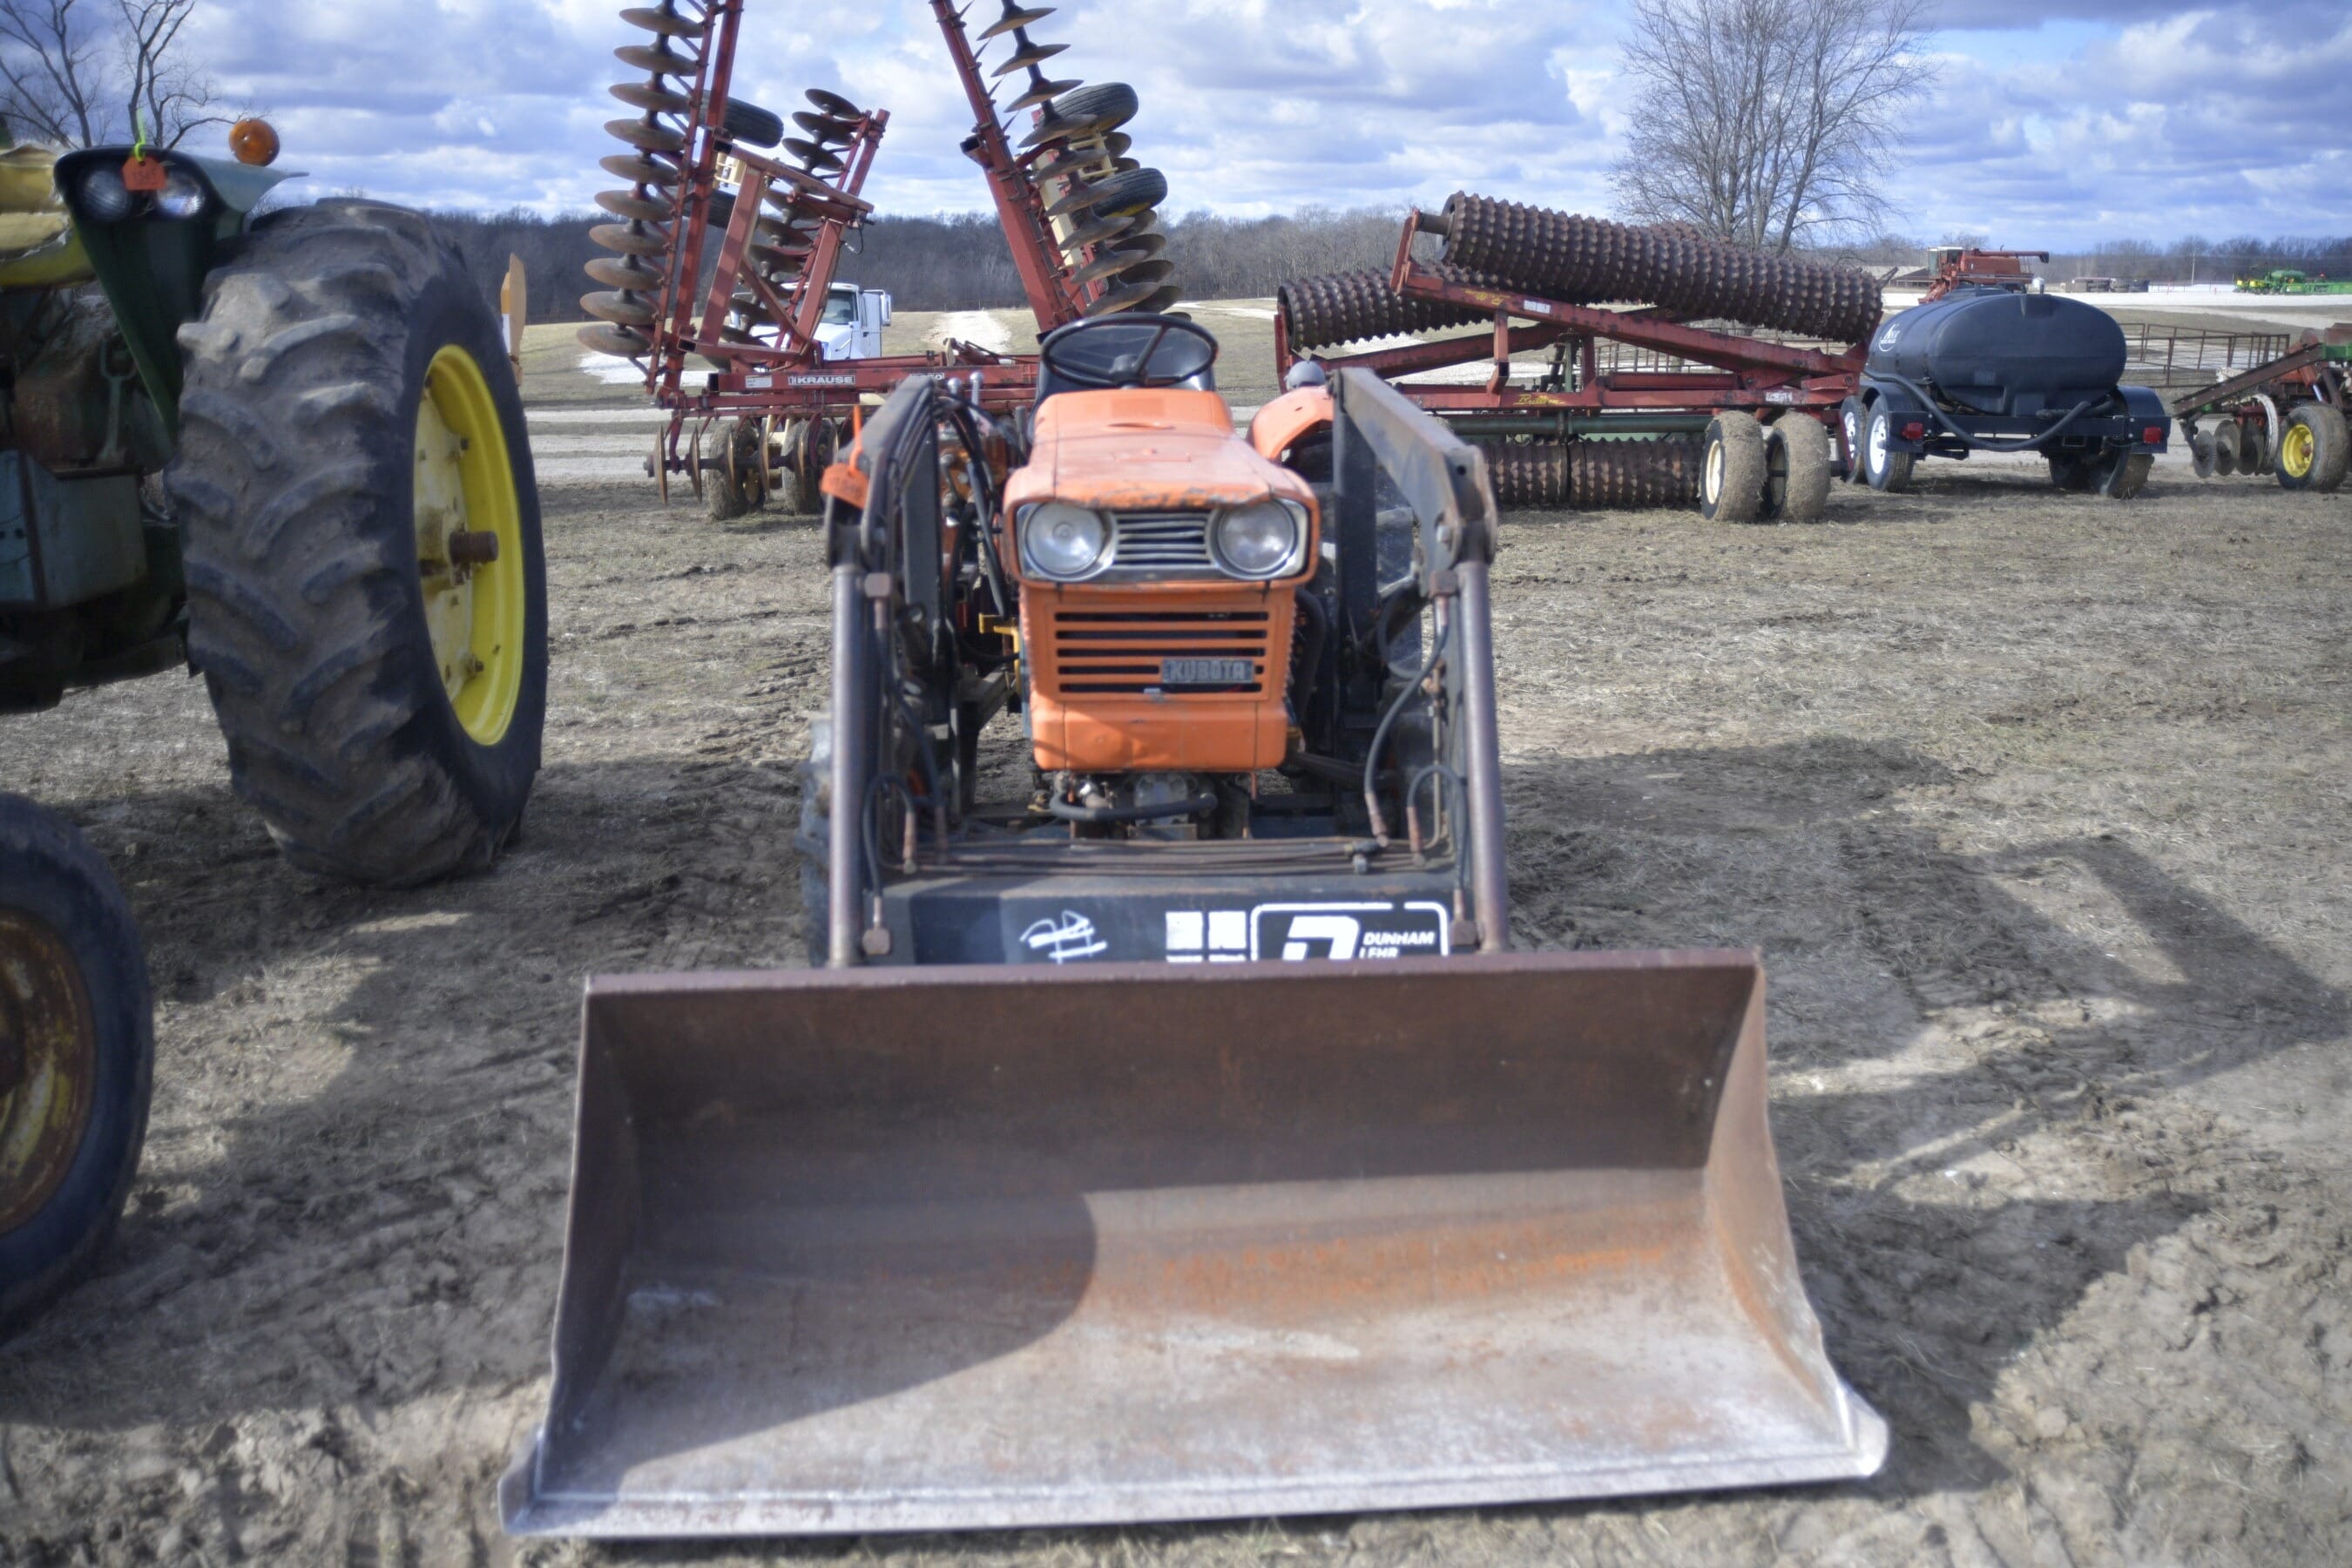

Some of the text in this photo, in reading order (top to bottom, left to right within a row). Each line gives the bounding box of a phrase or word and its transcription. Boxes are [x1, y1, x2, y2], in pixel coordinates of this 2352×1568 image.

[797, 375, 853, 384] KRAUSE
[1170, 660, 1246, 680] KUBOTA
[1362, 931, 1436, 946] DUNHAM
